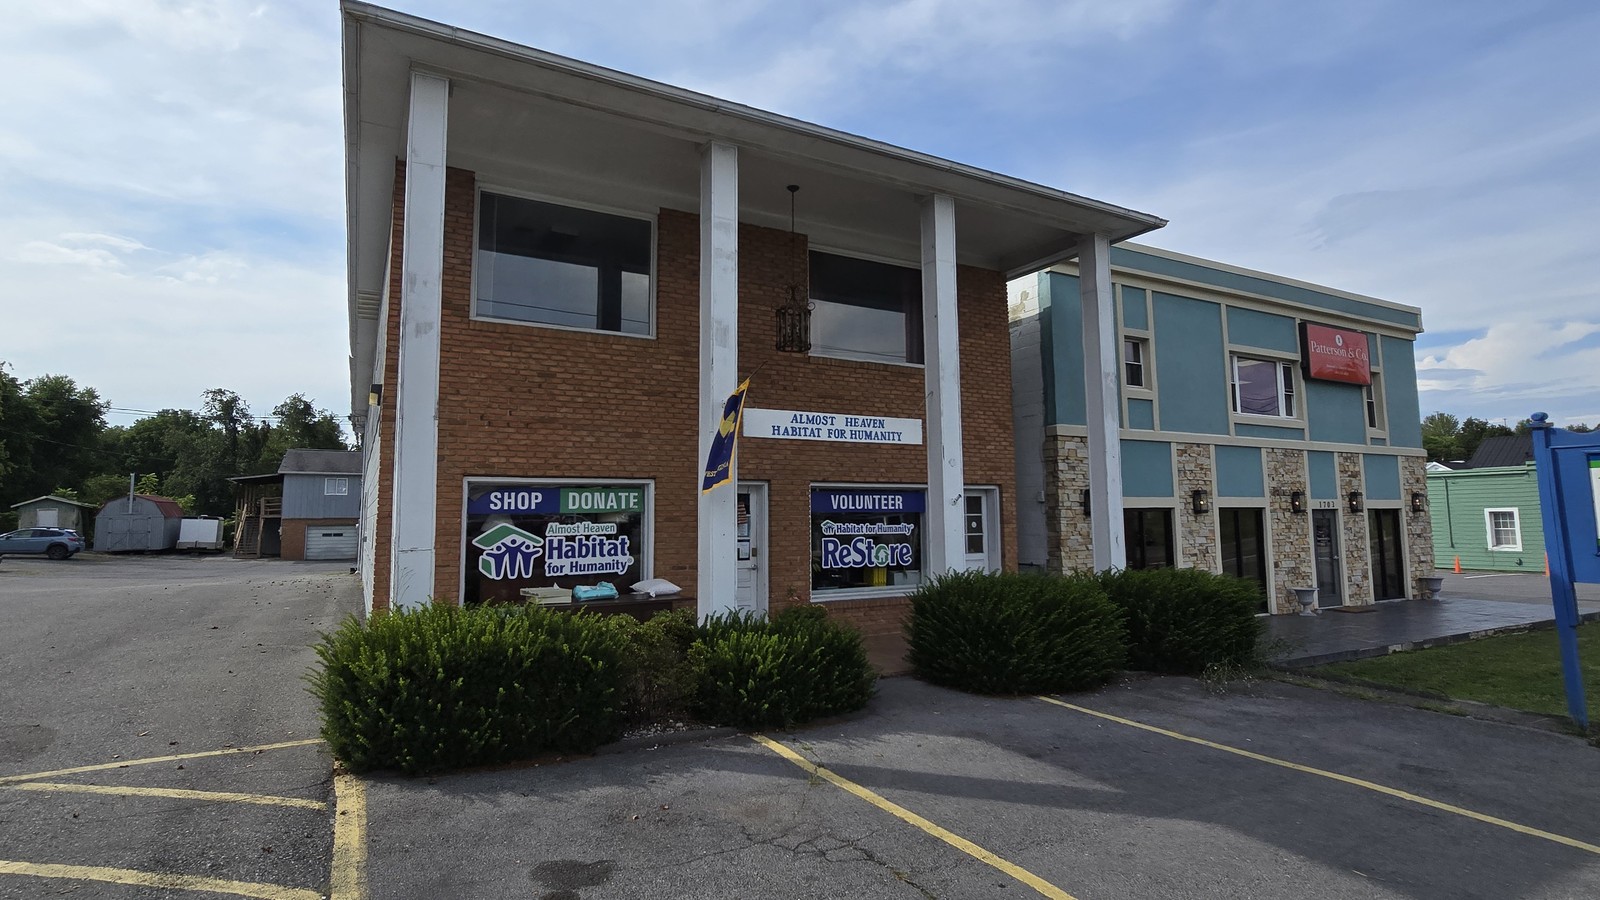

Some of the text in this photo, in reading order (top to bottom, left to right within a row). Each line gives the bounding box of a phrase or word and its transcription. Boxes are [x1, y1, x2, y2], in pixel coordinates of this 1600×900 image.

[1311, 341, 1346, 356] Patterson
[1348, 348, 1354, 358] &
[790, 414, 885, 429] ALMOST HEAVEN
[772, 426, 902, 442] HABITAT FOR HUMANITY
[490, 492, 638, 510] SHOP DONATE
[830, 494, 903, 510] VOLUNTEER
[547, 523, 615, 534] Almost Heaven
[836, 524, 864, 534] Habitat
[866, 524, 876, 533] for
[547, 536, 628, 560] Habitat
[822, 537, 912, 568] ReStore
[547, 562, 565, 574] for
